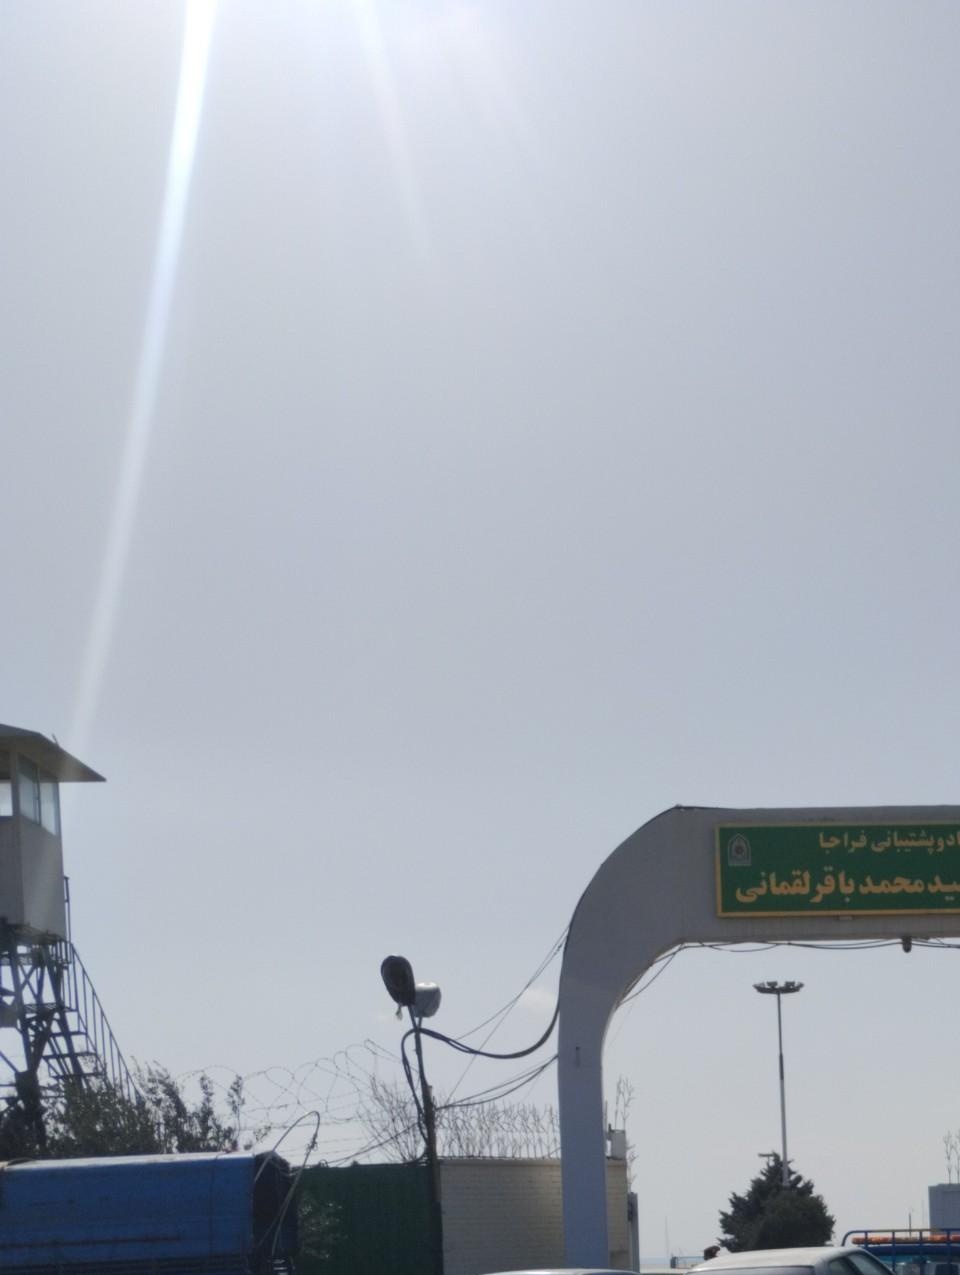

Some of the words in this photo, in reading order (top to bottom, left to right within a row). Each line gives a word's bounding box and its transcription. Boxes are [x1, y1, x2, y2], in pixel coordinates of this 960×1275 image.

[818, 829, 867, 854] فراجا
[871, 829, 934, 854] پشتیبانی
[937, 836, 945, 852] و
[735, 868, 810, 903] لقمانی
